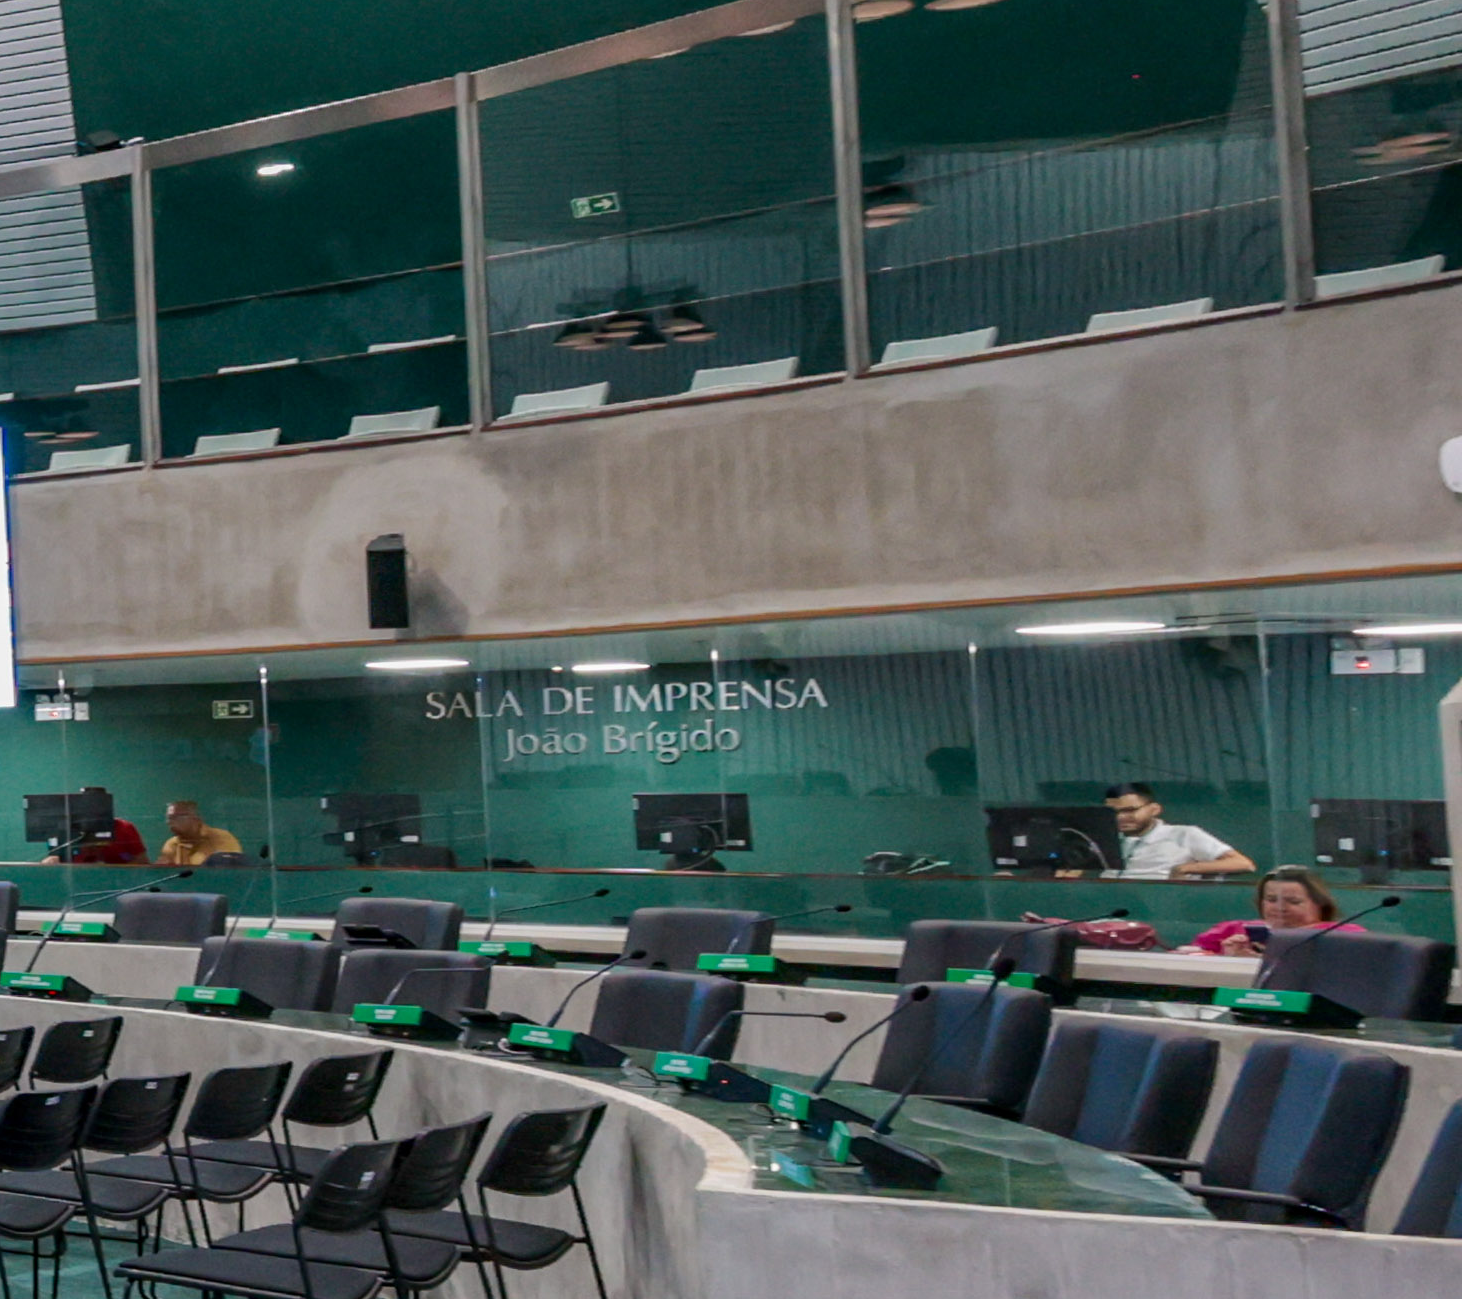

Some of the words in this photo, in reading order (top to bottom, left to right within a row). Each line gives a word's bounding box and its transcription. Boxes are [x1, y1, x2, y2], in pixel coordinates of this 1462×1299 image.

[424, 689, 524, 719] SALA
[542, 686, 595, 715] DE
[613, 677, 828, 713] IMPRENSA
[502, 727, 588, 762] João
[603, 718, 741, 764] Brígido
